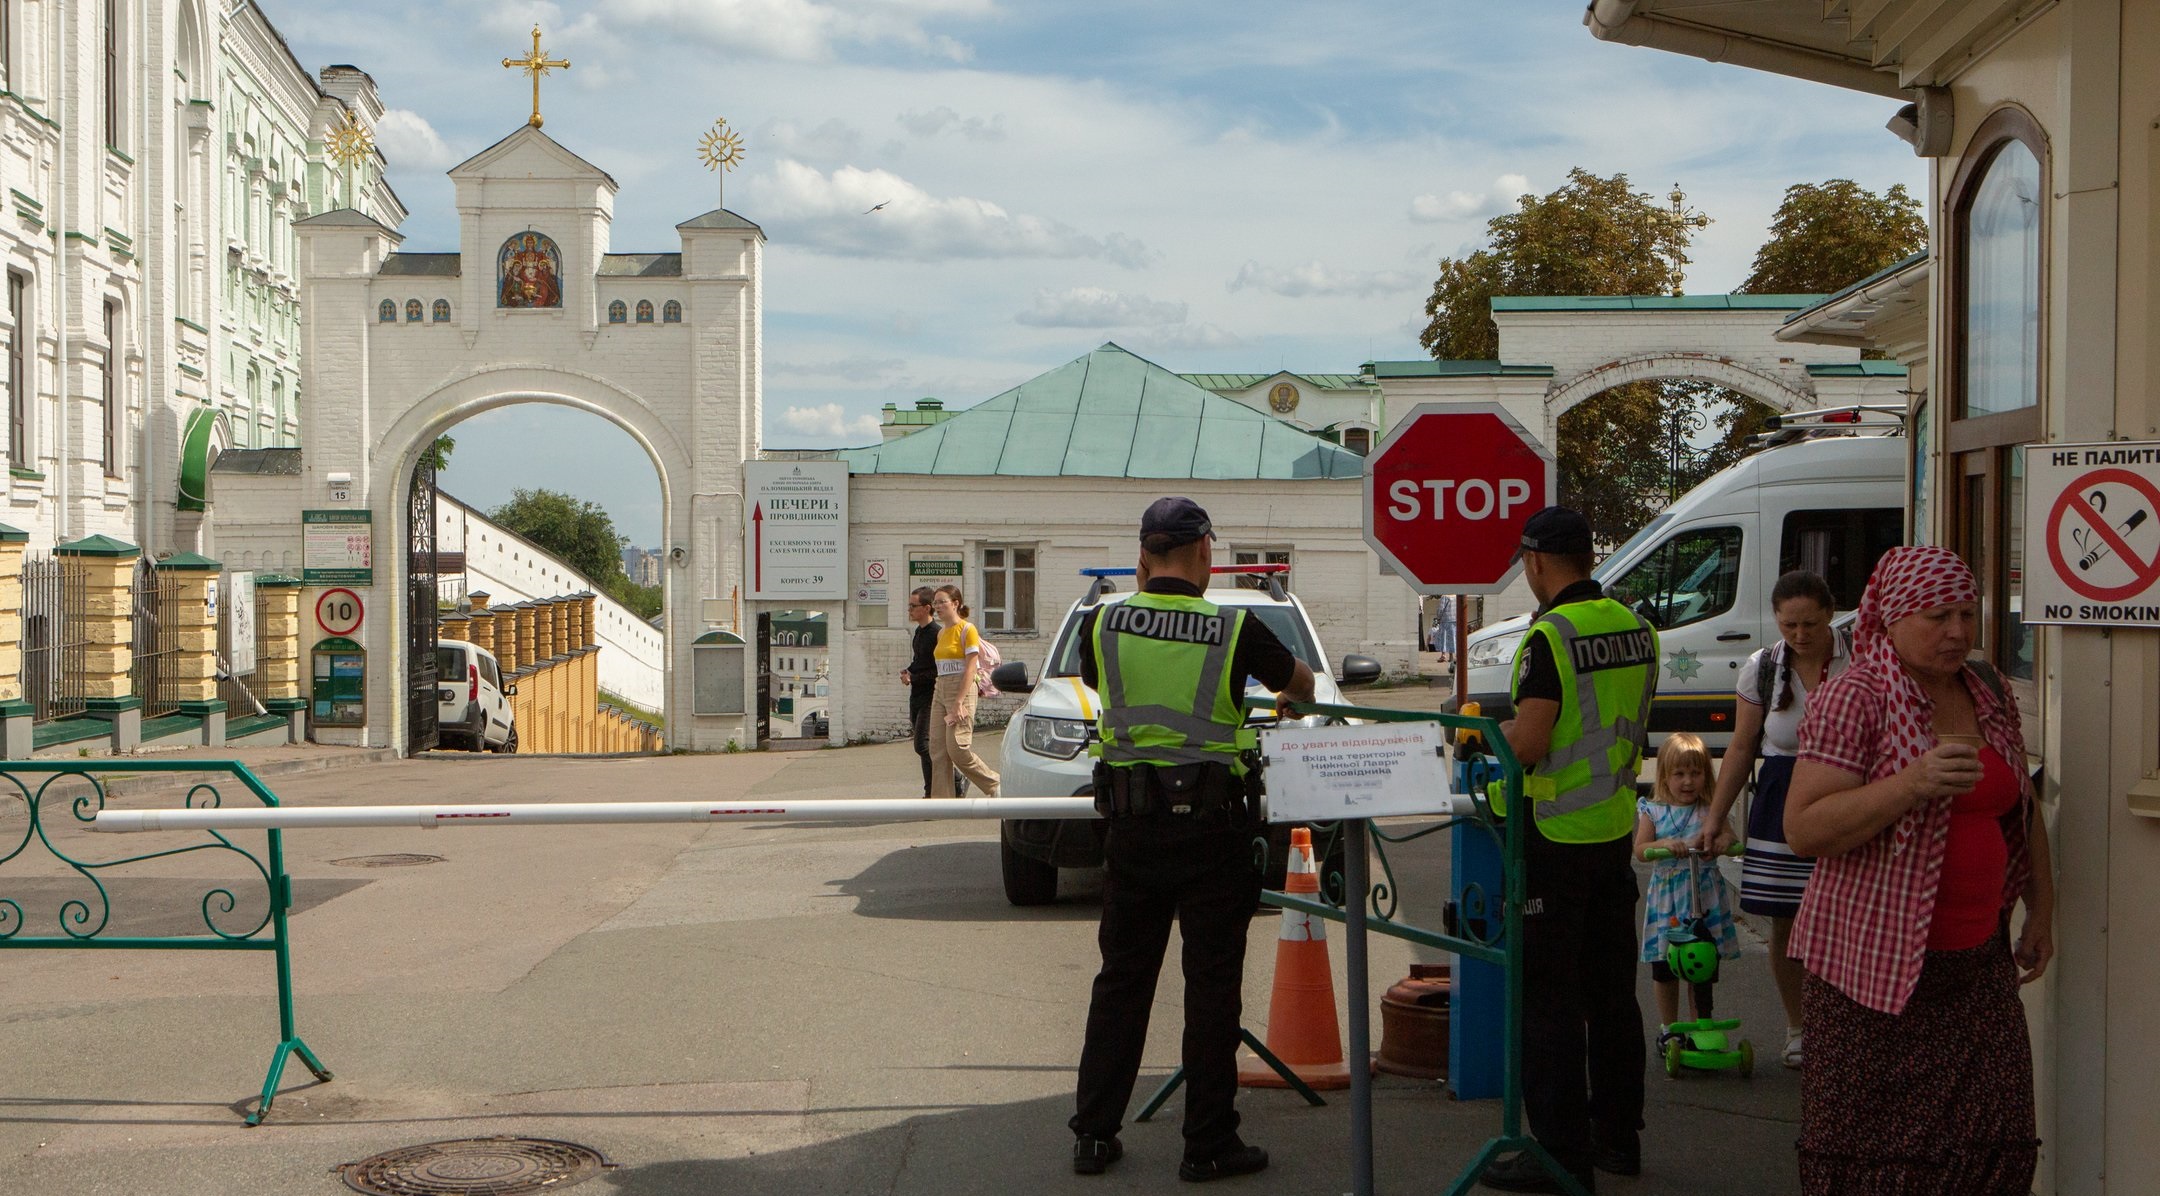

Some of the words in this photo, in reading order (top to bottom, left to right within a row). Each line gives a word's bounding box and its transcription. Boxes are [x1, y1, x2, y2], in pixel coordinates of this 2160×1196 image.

[2052, 452, 2078, 466] НЕ
[335, 492, 346, 500] 15
[1388, 478, 1531, 521] STOP
[770, 499, 829, 510] ПЕЧЕРИ
[770, 513, 838, 521] ПРОВІДНИКОМ
[812, 575, 824, 585] 39
[327, 602, 352, 621] 10
[2045, 604, 2073, 619] NO
[2079, 604, 2160, 621] SMOKIN
[1109, 606, 1222, 643] ПОЛІЦІЯ
[1574, 631, 1655, 668] ПОЛІЦІЯ
[1281, 742, 1299, 751] До
[1302, 741, 1338, 750] уваги
[1302, 755, 1327, 763] Вхід
[1346, 750, 1406, 760] територію
[1311, 761, 1360, 770] Нижньої
[1363, 760, 1399, 768] Лаври
[1319, 768, 1392, 778] Заповідника
